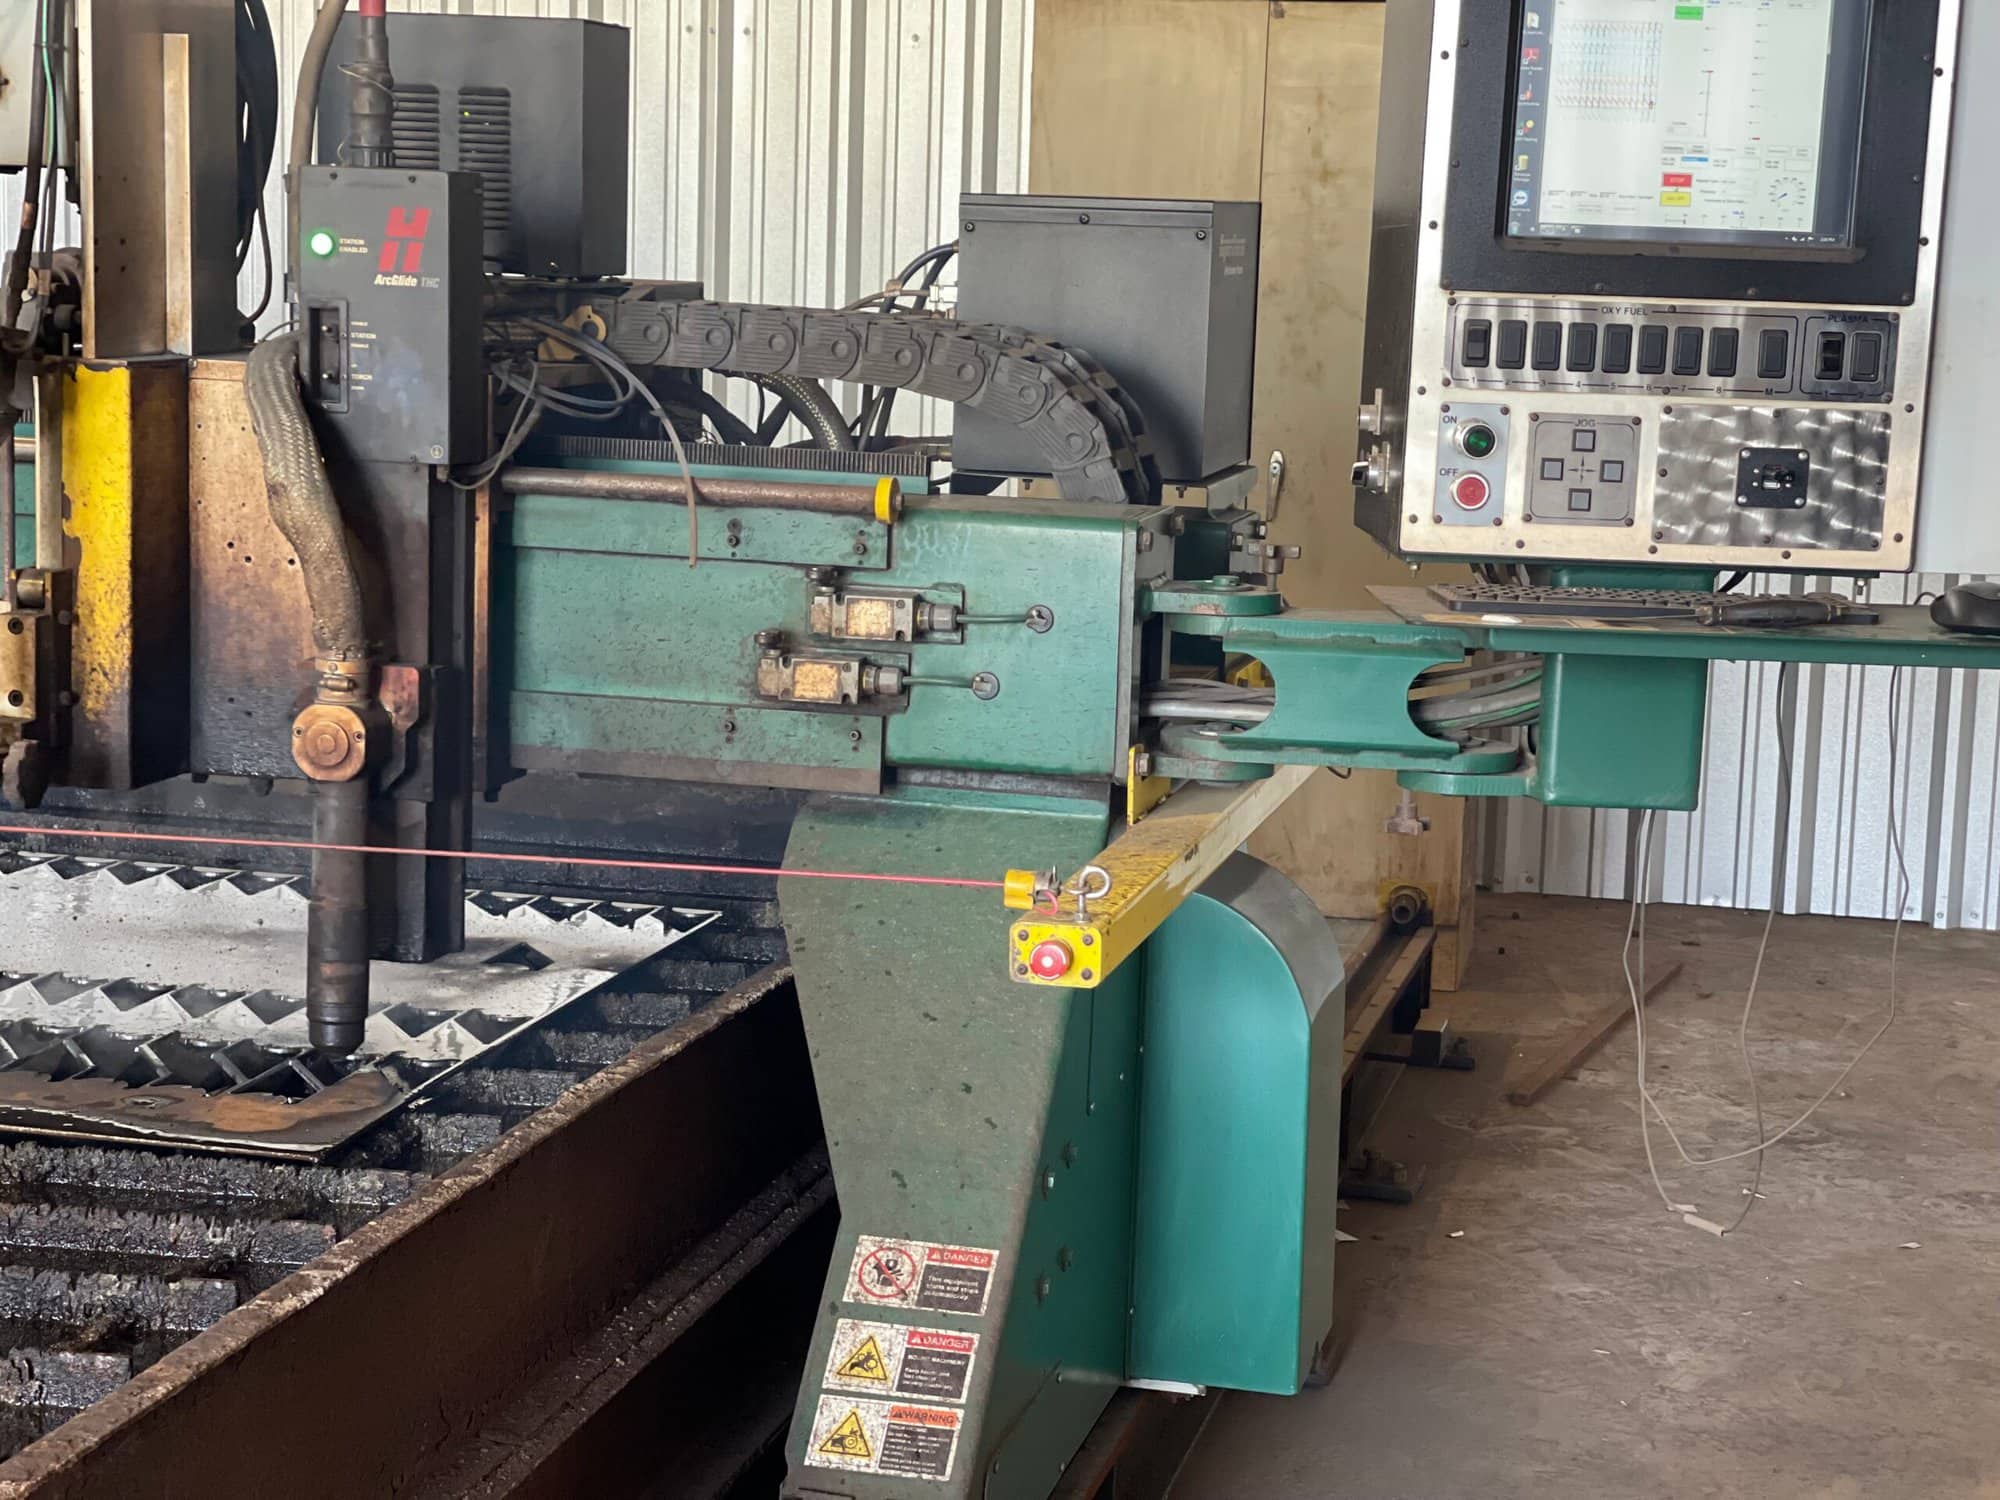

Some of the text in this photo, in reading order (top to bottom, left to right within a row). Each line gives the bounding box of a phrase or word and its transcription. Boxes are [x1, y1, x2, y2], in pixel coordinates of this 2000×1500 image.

[374, 274, 418, 287] ArcGlide
[1601, 306, 1648, 316] OXY FUEL
[1443, 415, 1457, 424] ON
[1440, 467, 1459, 476] OFF
[943, 1252, 989, 1264] DANGER
[923, 1335, 969, 1349] DANGER
[904, 1410, 954, 1424] WARNING
